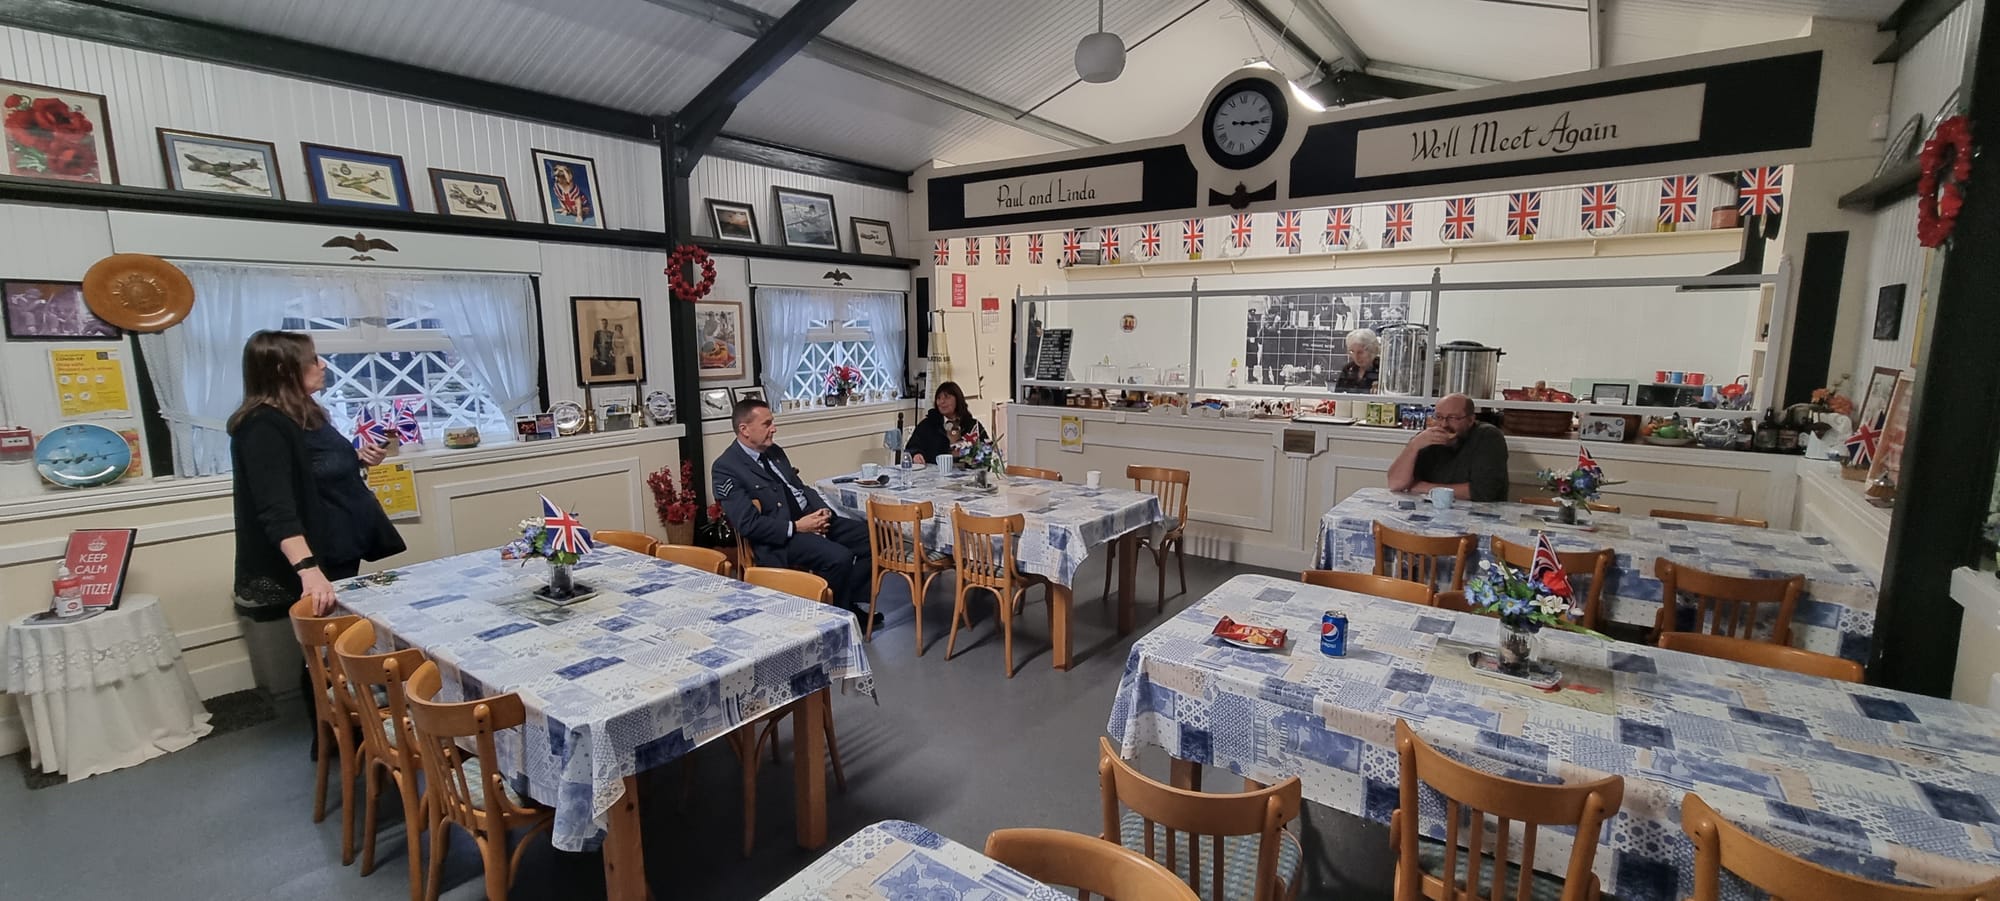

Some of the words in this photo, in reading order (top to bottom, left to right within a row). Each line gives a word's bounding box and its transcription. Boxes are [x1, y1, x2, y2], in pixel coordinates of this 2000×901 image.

[1412, 125, 1461, 162] We'll
[1470, 119, 1538, 155] Meet
[1538, 110, 1619, 154] Again
[996, 181, 1026, 208] Paul
[1028, 179, 1054, 206] and
[1057, 174, 1096, 202] Linda
[79, 553, 108, 563] KEEP
[74, 565, 108, 574] CALM
